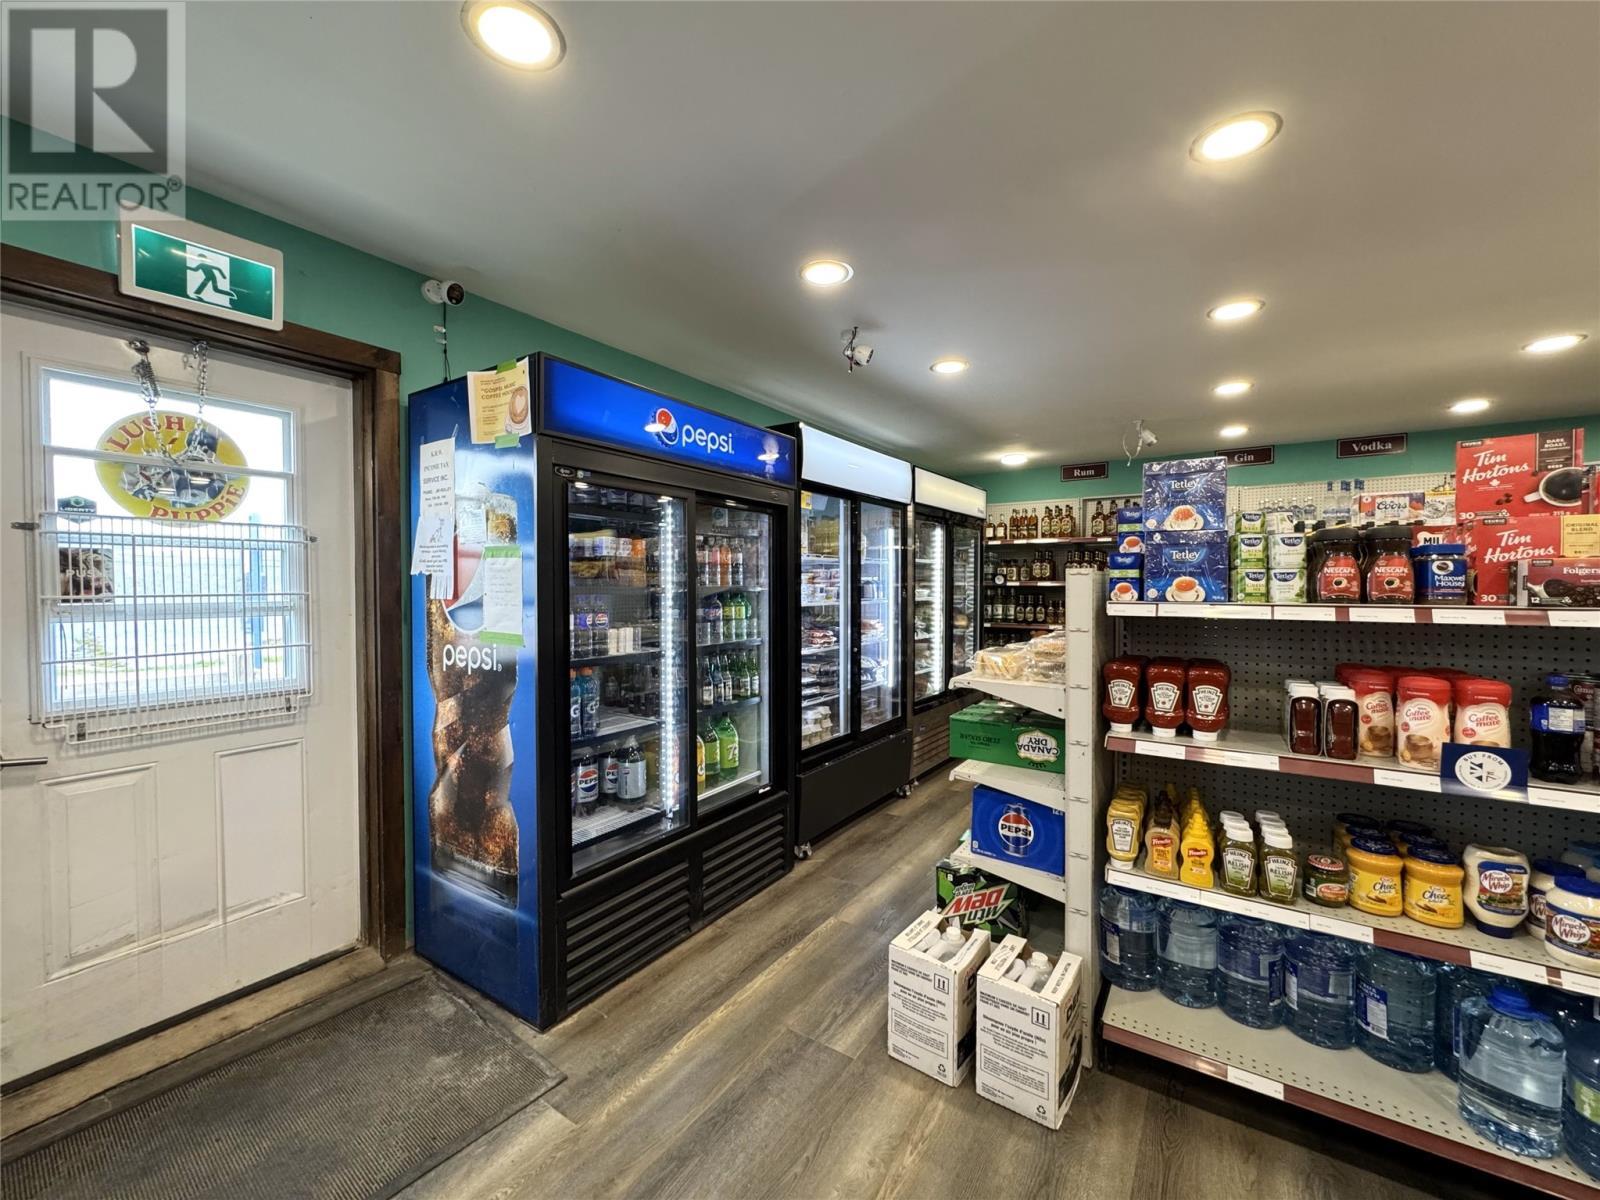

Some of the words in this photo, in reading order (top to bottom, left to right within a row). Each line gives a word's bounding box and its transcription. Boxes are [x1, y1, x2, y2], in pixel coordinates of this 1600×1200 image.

[105, 415, 185, 451] LUSH
[682, 424, 732, 454] pepsi
[1352, 440, 1393, 453] Vodka
[1234, 453, 1254, 463] Gin
[1473, 449, 1507, 467] Tim
[1073, 467, 1095, 477] Rum
[1462, 462, 1529, 485] Hortons
[1170, 479, 1200, 491] Tetley
[1377, 500, 1407, 511] Coors
[1496, 529, 1532, 547] Tim
[1169, 550, 1201, 561] Tetley
[1484, 545, 1555, 564] Hortons
[1276, 572, 1294, 580] Tetley
[1480, 594, 1497, 602] 30
[442, 643, 498, 675] pepsi
[1405, 708, 1431, 718] Coffee
[1469, 713, 1499, 723] Coffee
[1476, 719, 1500, 727] mate
[1028, 736, 1048, 746] DRY
[1016, 743, 1059, 756] CANADA
[1482, 753, 1504, 766] FROM
[579, 777, 598, 786] PEPS
[1001, 823, 1032, 837] PEPSI
[1228, 860, 1249, 869] RELISH
[1271, 858, 1290, 866] HEINZ
[1270, 868, 1292, 876] RELISH
[1482, 873, 1510, 881] Miracle
[1489, 880, 1510, 890] Whip
[1422, 889, 1451, 900] Cheez
[1555, 916, 1586, 931] Miracle
[1560, 928, 1587, 940] Whip
